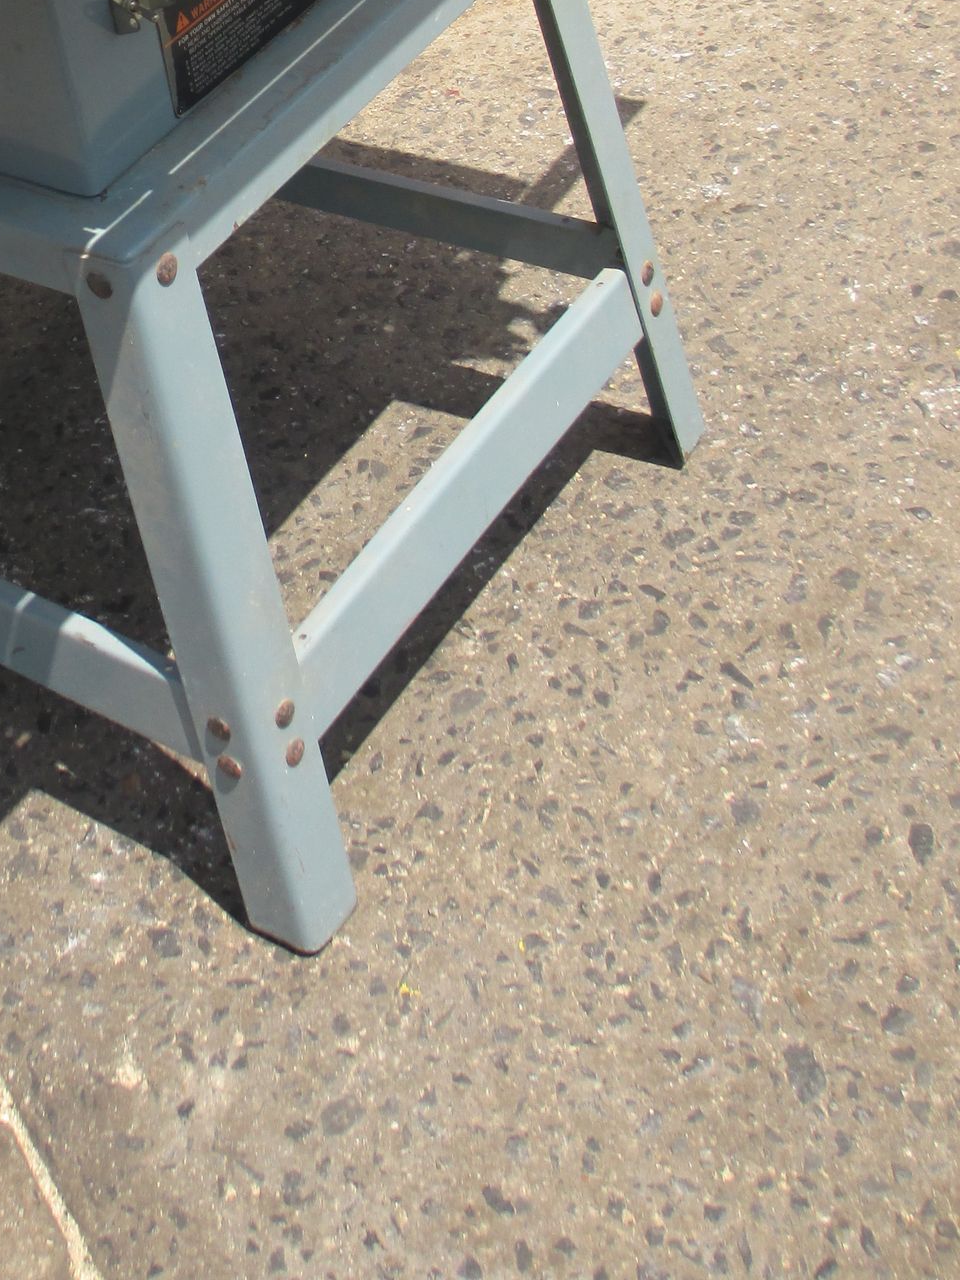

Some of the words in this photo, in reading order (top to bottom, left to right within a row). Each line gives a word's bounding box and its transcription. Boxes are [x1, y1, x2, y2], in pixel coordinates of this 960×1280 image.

[178, 34, 190, 48] FOR
[190, 22, 204, 38] YOUR
[204, 10, 216, 26] OWN
